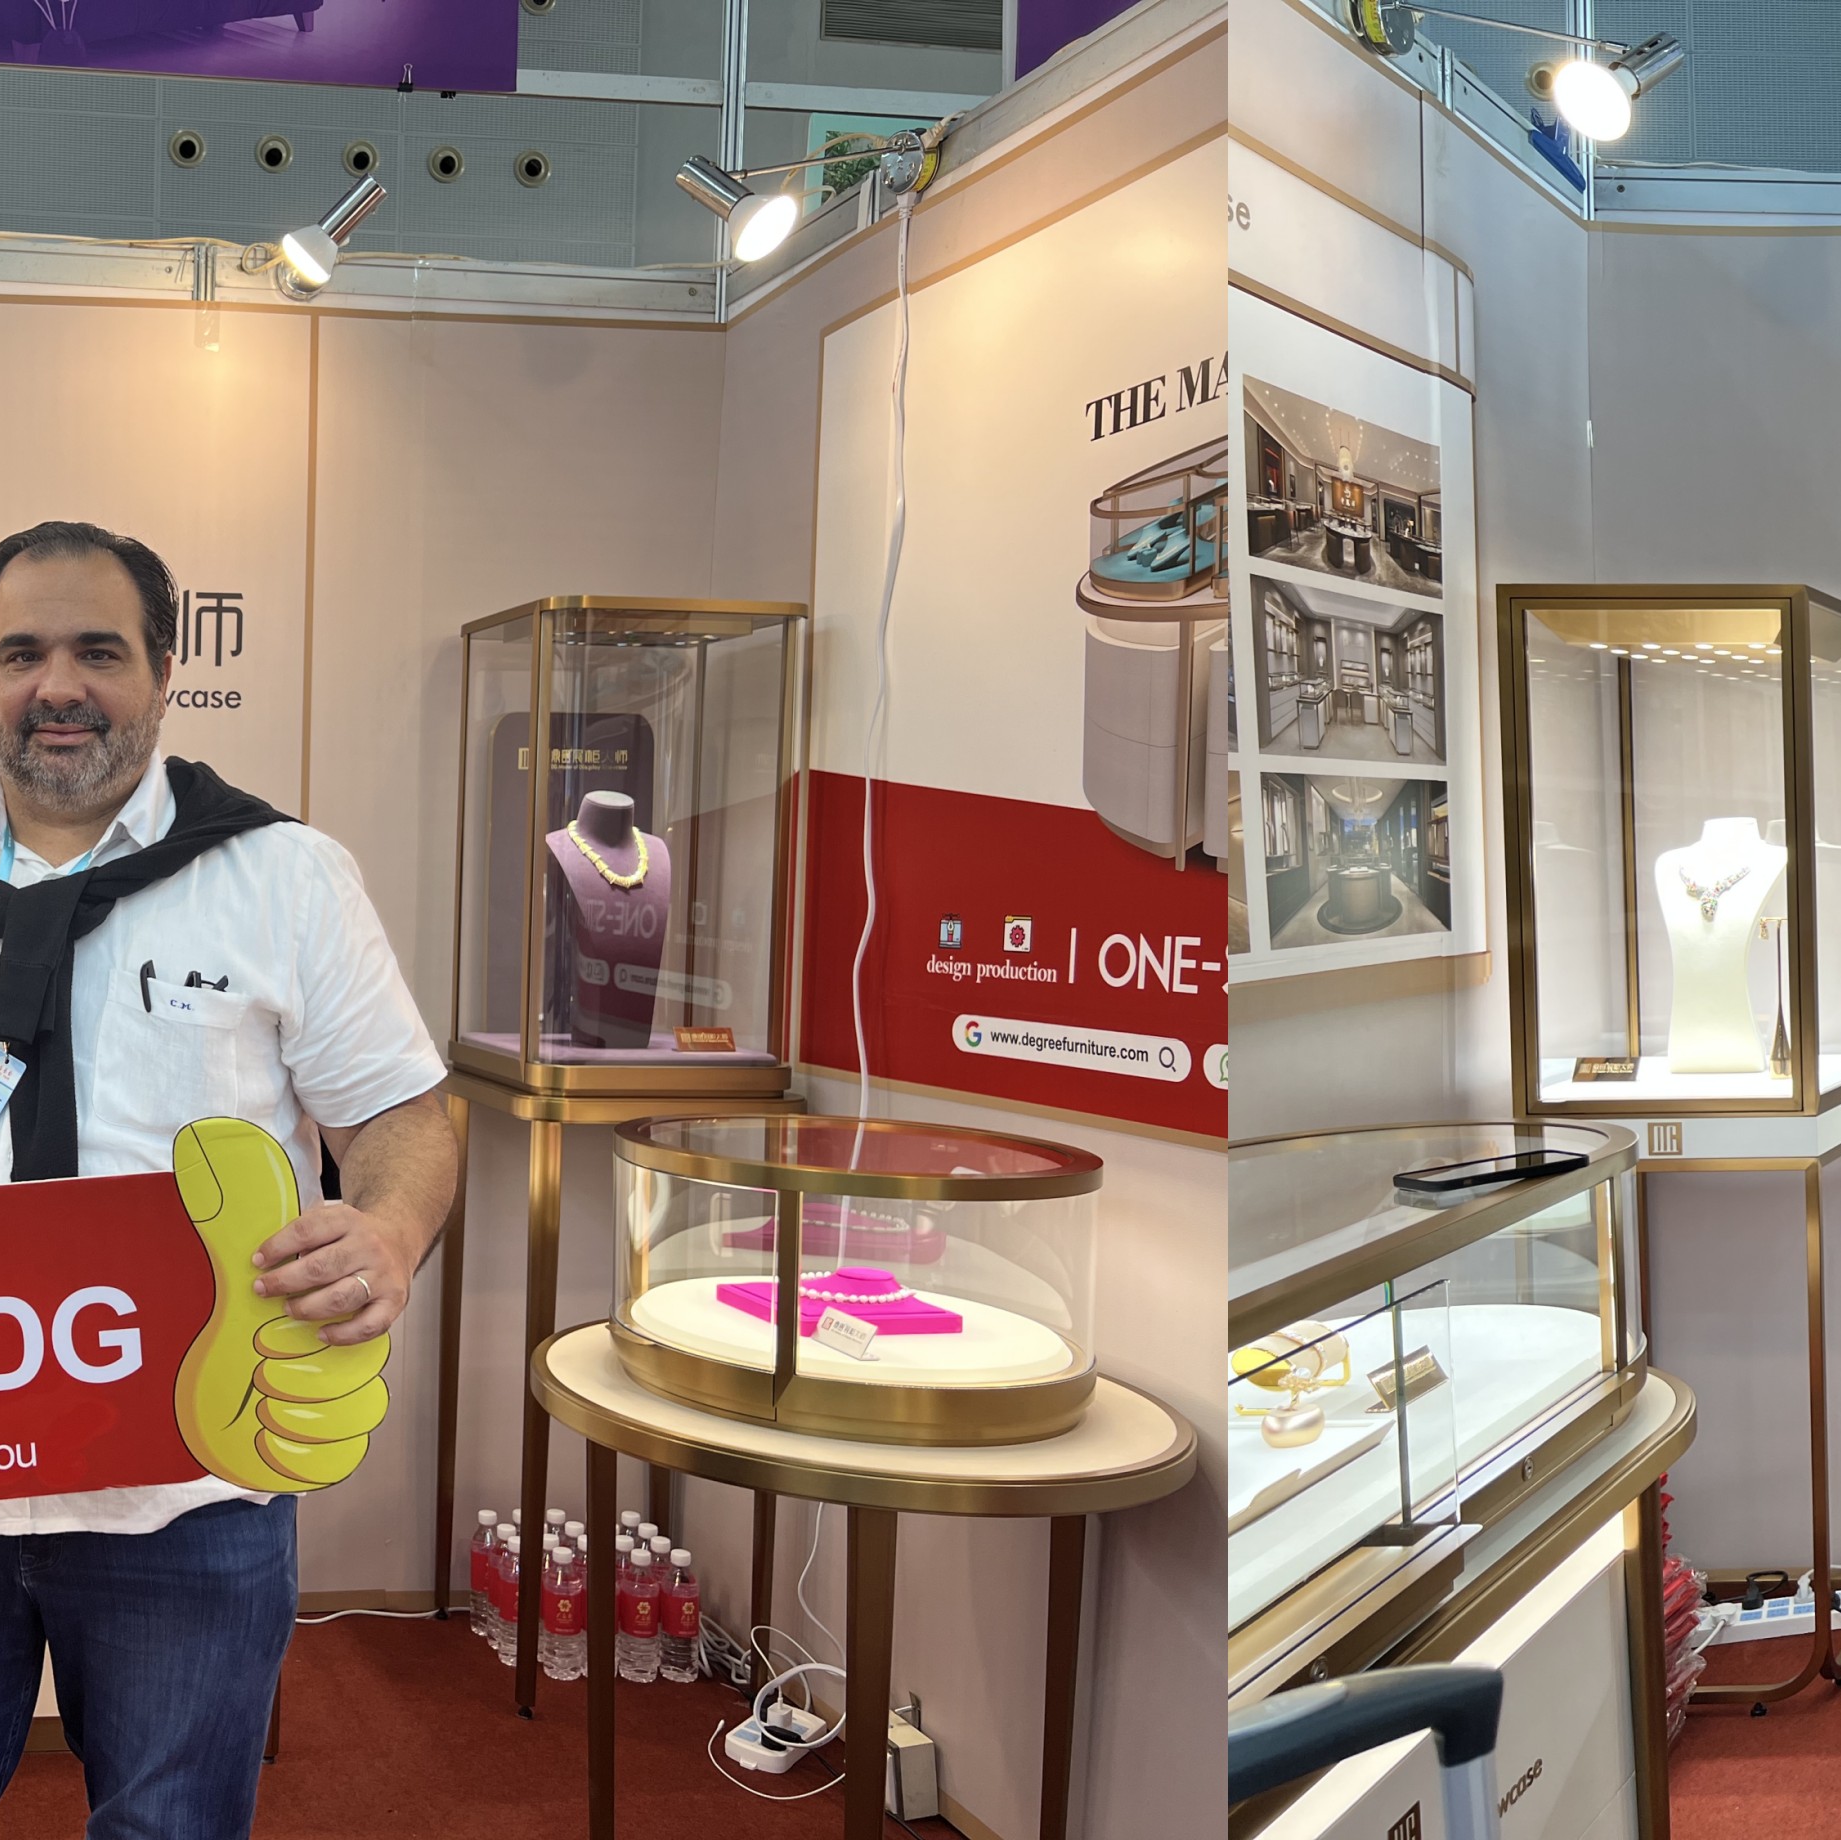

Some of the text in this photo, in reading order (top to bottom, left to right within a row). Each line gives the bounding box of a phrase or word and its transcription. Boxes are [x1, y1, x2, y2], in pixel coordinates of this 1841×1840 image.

[1085, 374, 1166, 442] THE
[926, 932, 1228, 995] design production ONE-
[990, 1027, 1149, 1063] www.degreefurniture.com
[1652, 1125, 1679, 1153] DG
